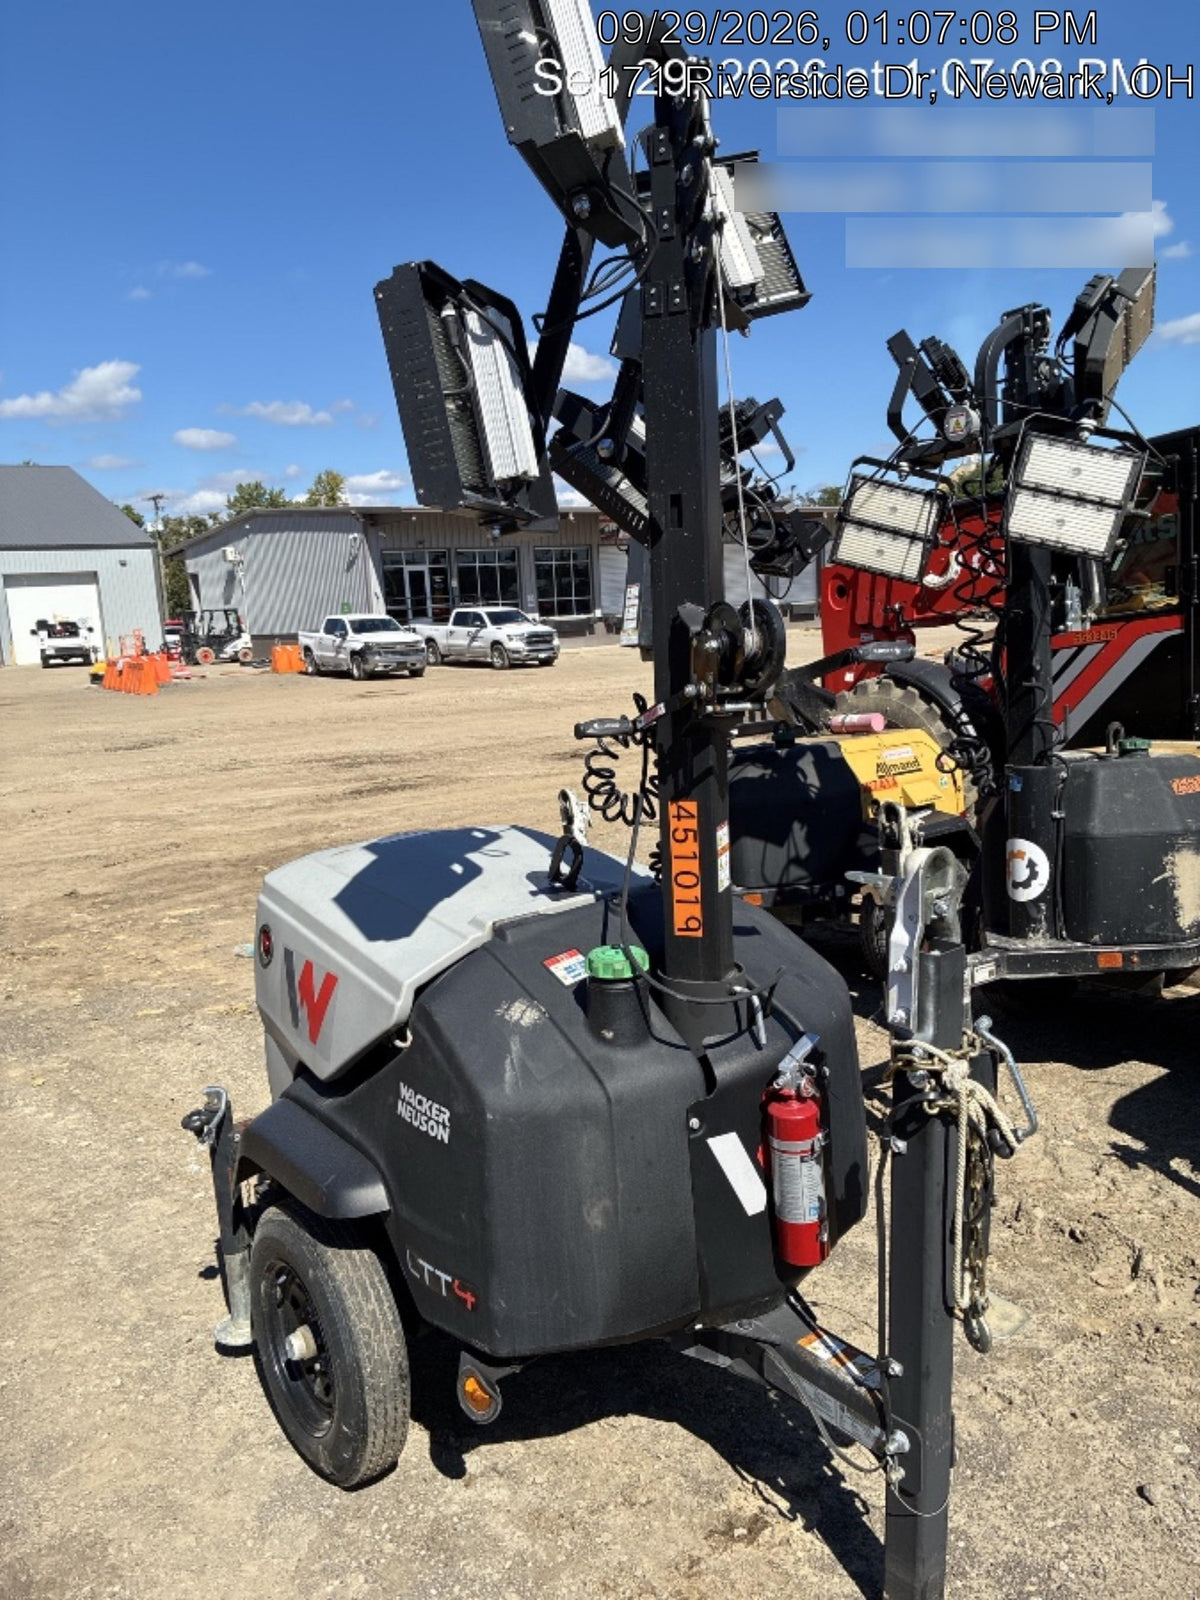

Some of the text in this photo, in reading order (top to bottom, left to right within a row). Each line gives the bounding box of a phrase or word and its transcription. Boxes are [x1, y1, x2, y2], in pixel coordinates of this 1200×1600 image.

[671, 804, 702, 934] 451019
[397, 1099, 450, 1144] NEUSON
[400, 1081, 451, 1127] WACKER
